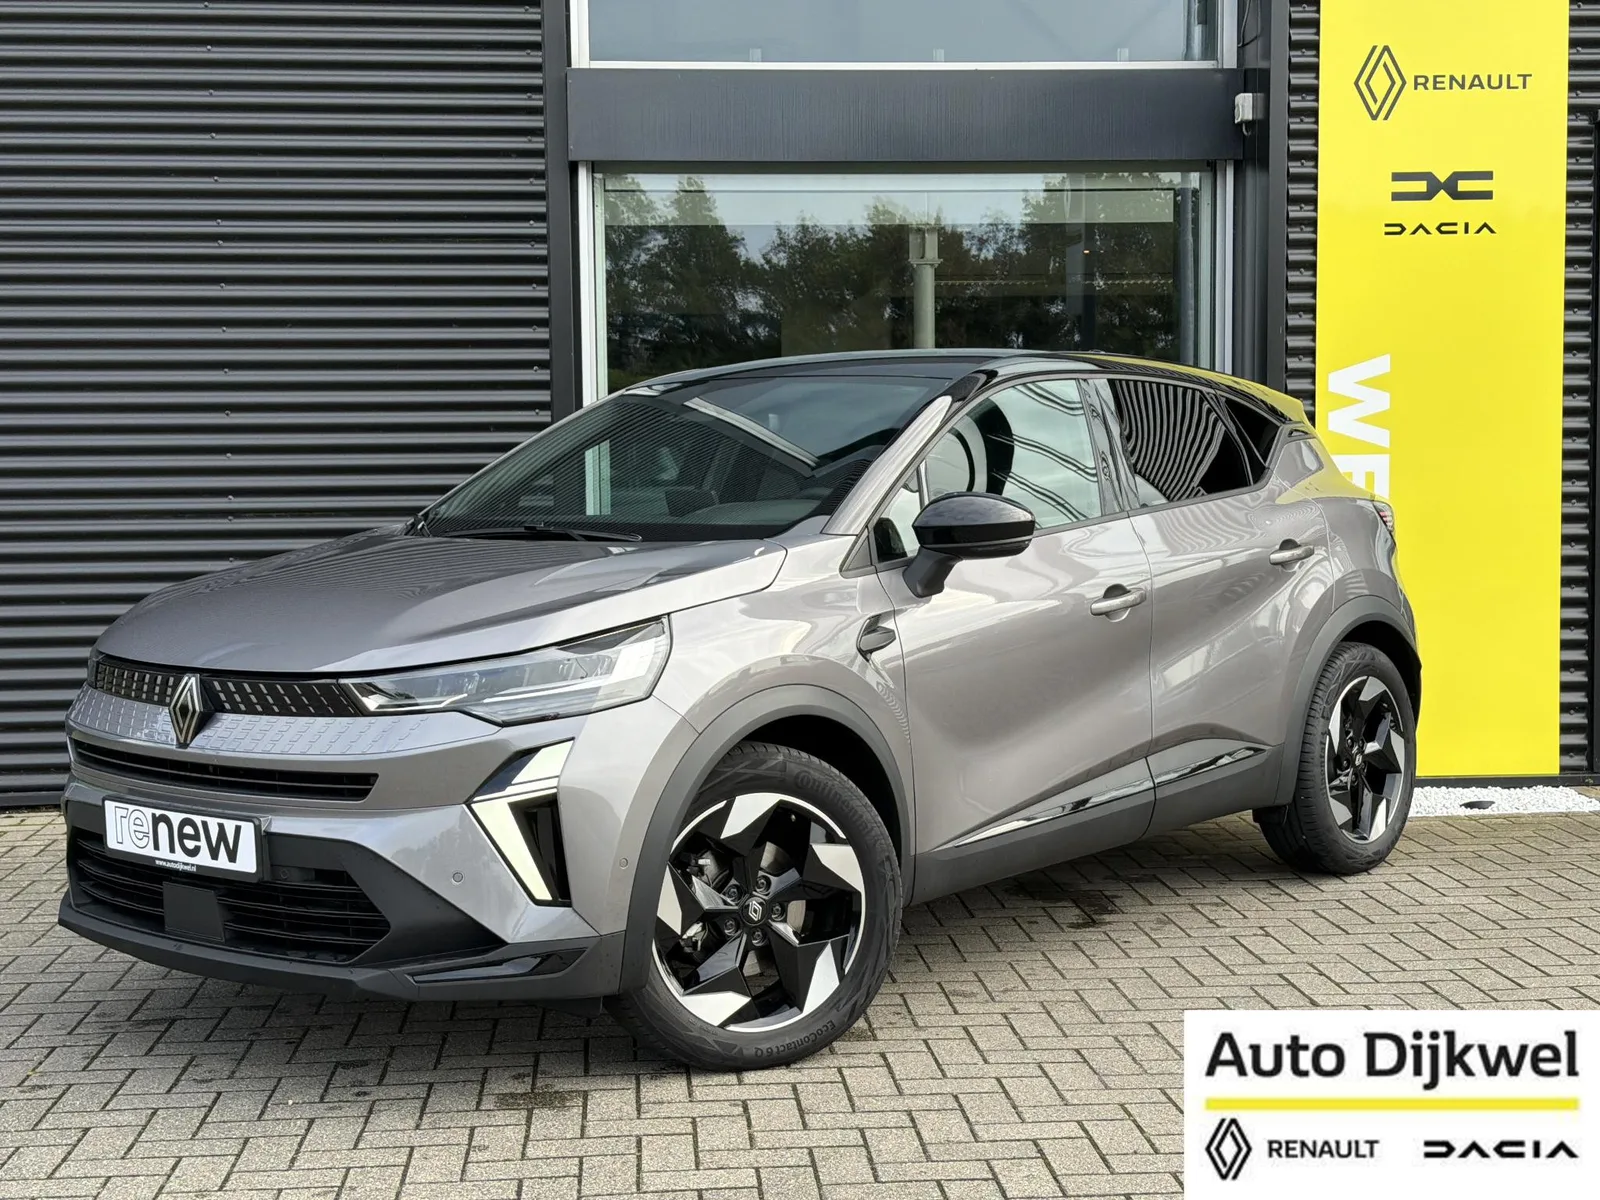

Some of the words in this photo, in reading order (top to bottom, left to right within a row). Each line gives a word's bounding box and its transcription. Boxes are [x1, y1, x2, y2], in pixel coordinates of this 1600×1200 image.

[1413, 73, 1533, 91] RENAULT
[1383, 221, 1497, 236] DACIA
[114, 805, 242, 864] renew
[155, 859, 197, 872] www.autodijkwel.nl
[775, 1020, 836, 1055] EcoContact
